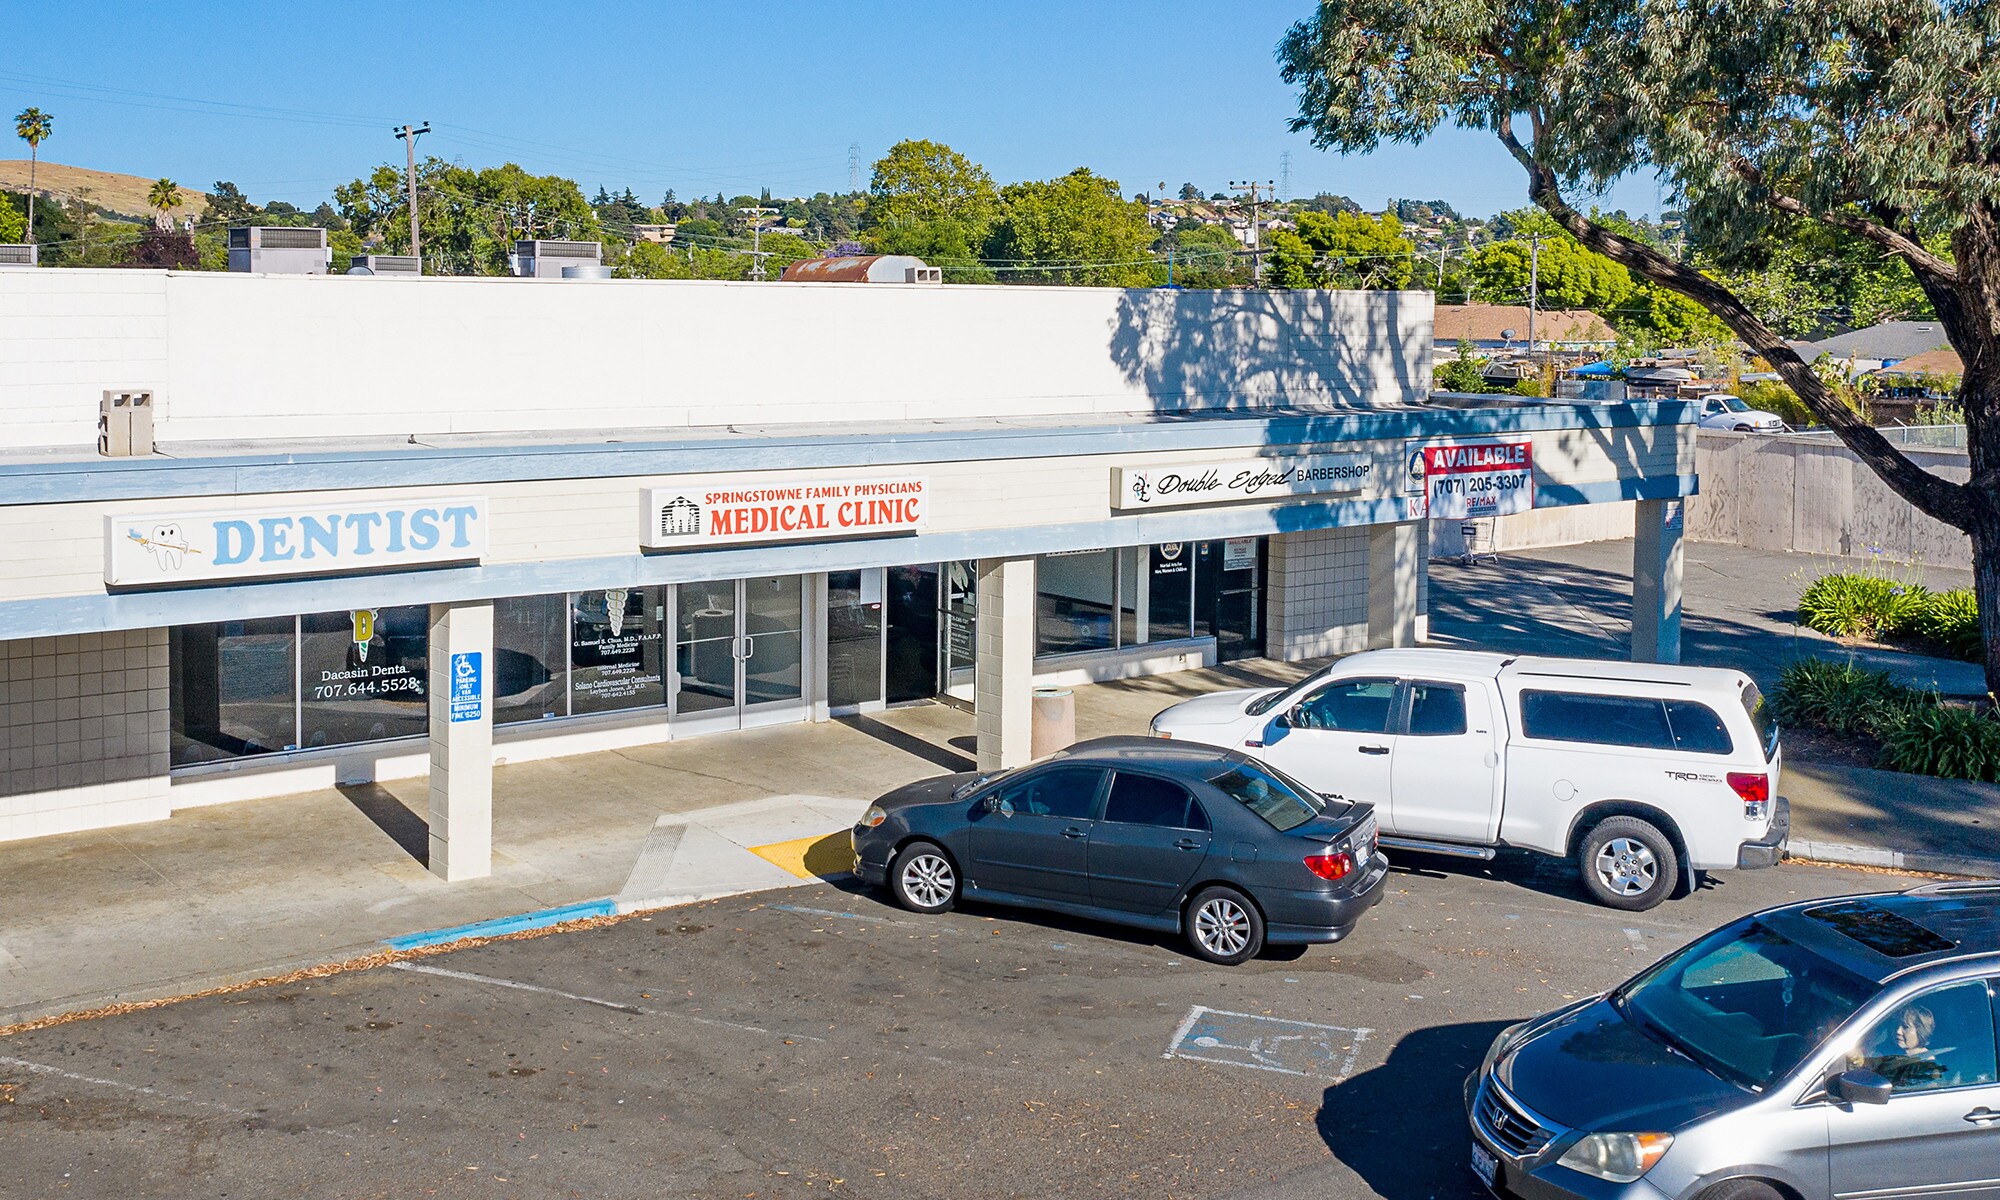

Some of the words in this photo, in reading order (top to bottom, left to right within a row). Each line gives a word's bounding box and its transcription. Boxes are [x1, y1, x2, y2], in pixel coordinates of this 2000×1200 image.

[1433, 445, 1525, 469] AVAILABLE
[1156, 468, 1222, 494] Double
[1228, 465, 1295, 494] Edged
[1296, 465, 1370, 482] BARBERSHOP
[1434, 478, 1466, 498] (707)
[1469, 474, 1527, 492] 205-3307
[705, 488, 803, 505] SPRINGSTOWNE
[806, 486, 851, 499] FAMILY
[854, 481, 923, 496] PHYSICIANS
[1466, 496, 1497, 507] RE/MAX
[709, 503, 830, 536] MEDICAL
[837, 497, 921, 527] CLINIC
[212, 504, 478, 566] DENTIST
[321, 667, 369, 682] Dacasin
[372, 663, 410, 676] Denta
[456, 676, 477, 684] PARKING
[453, 703, 479, 711] MINIMUM
